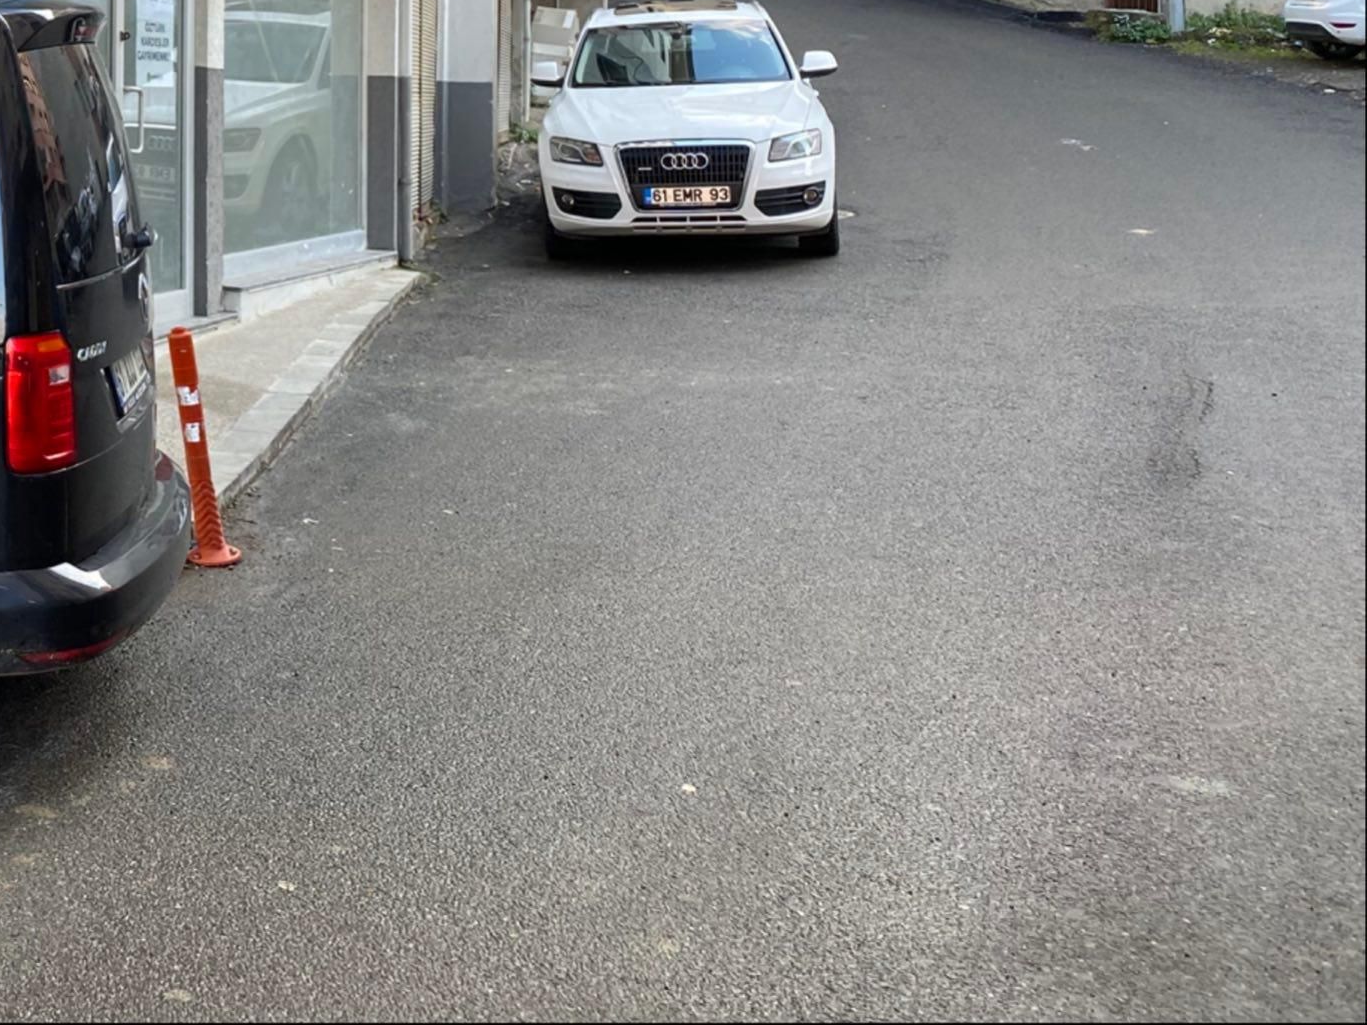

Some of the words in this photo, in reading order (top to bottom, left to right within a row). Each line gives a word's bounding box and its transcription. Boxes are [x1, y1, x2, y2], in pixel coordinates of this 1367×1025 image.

[652, 189, 668, 202] 61
[673, 188, 703, 202] EMR
[709, 187, 729, 201] 93
